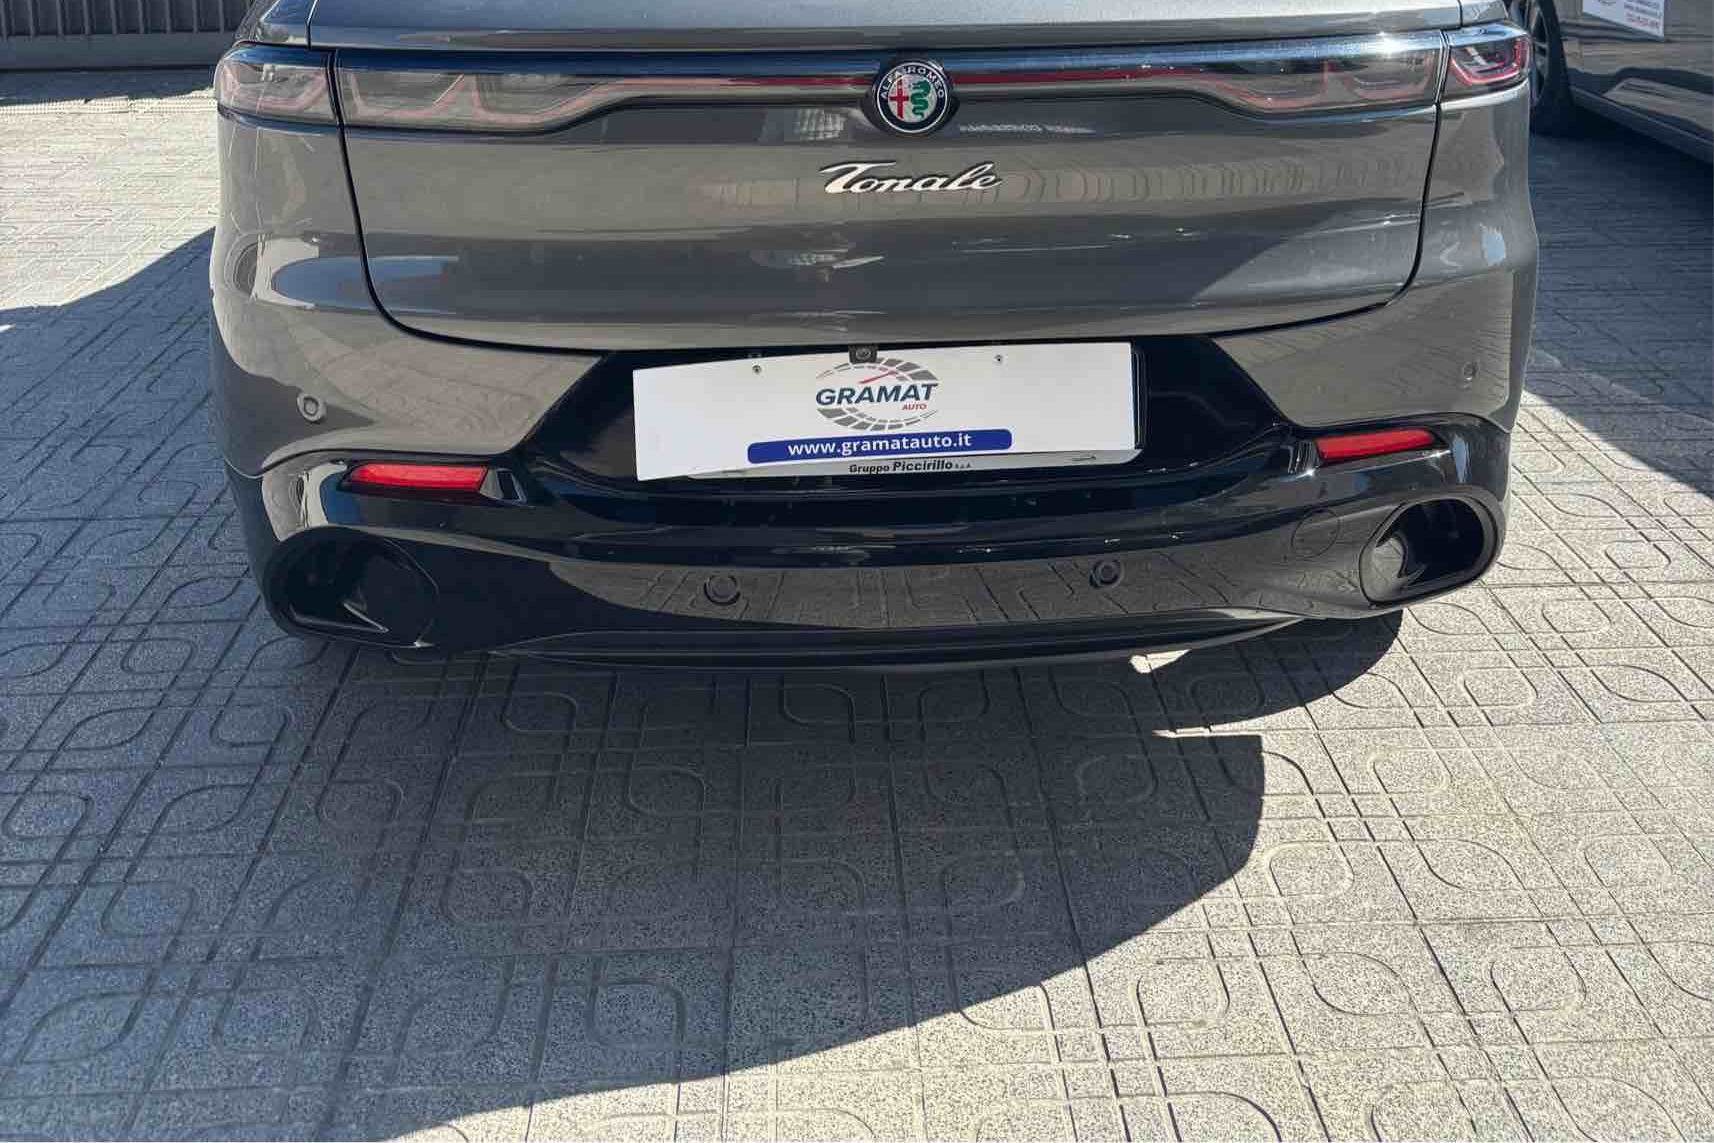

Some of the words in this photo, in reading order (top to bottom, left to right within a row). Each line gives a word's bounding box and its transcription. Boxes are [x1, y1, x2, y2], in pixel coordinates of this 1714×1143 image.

[880, 70, 903, 99] ALFA
[907, 66, 945, 98] ROMEO
[818, 161, 1002, 194] Tonale
[816, 383, 939, 406] GRAMAT
[902, 403, 927, 411] AUTO
[788, 433, 972, 456] www.gramatauto.it
[849, 464, 890, 474] Gruppo
[892, 460, 953, 472] Piccirillo
